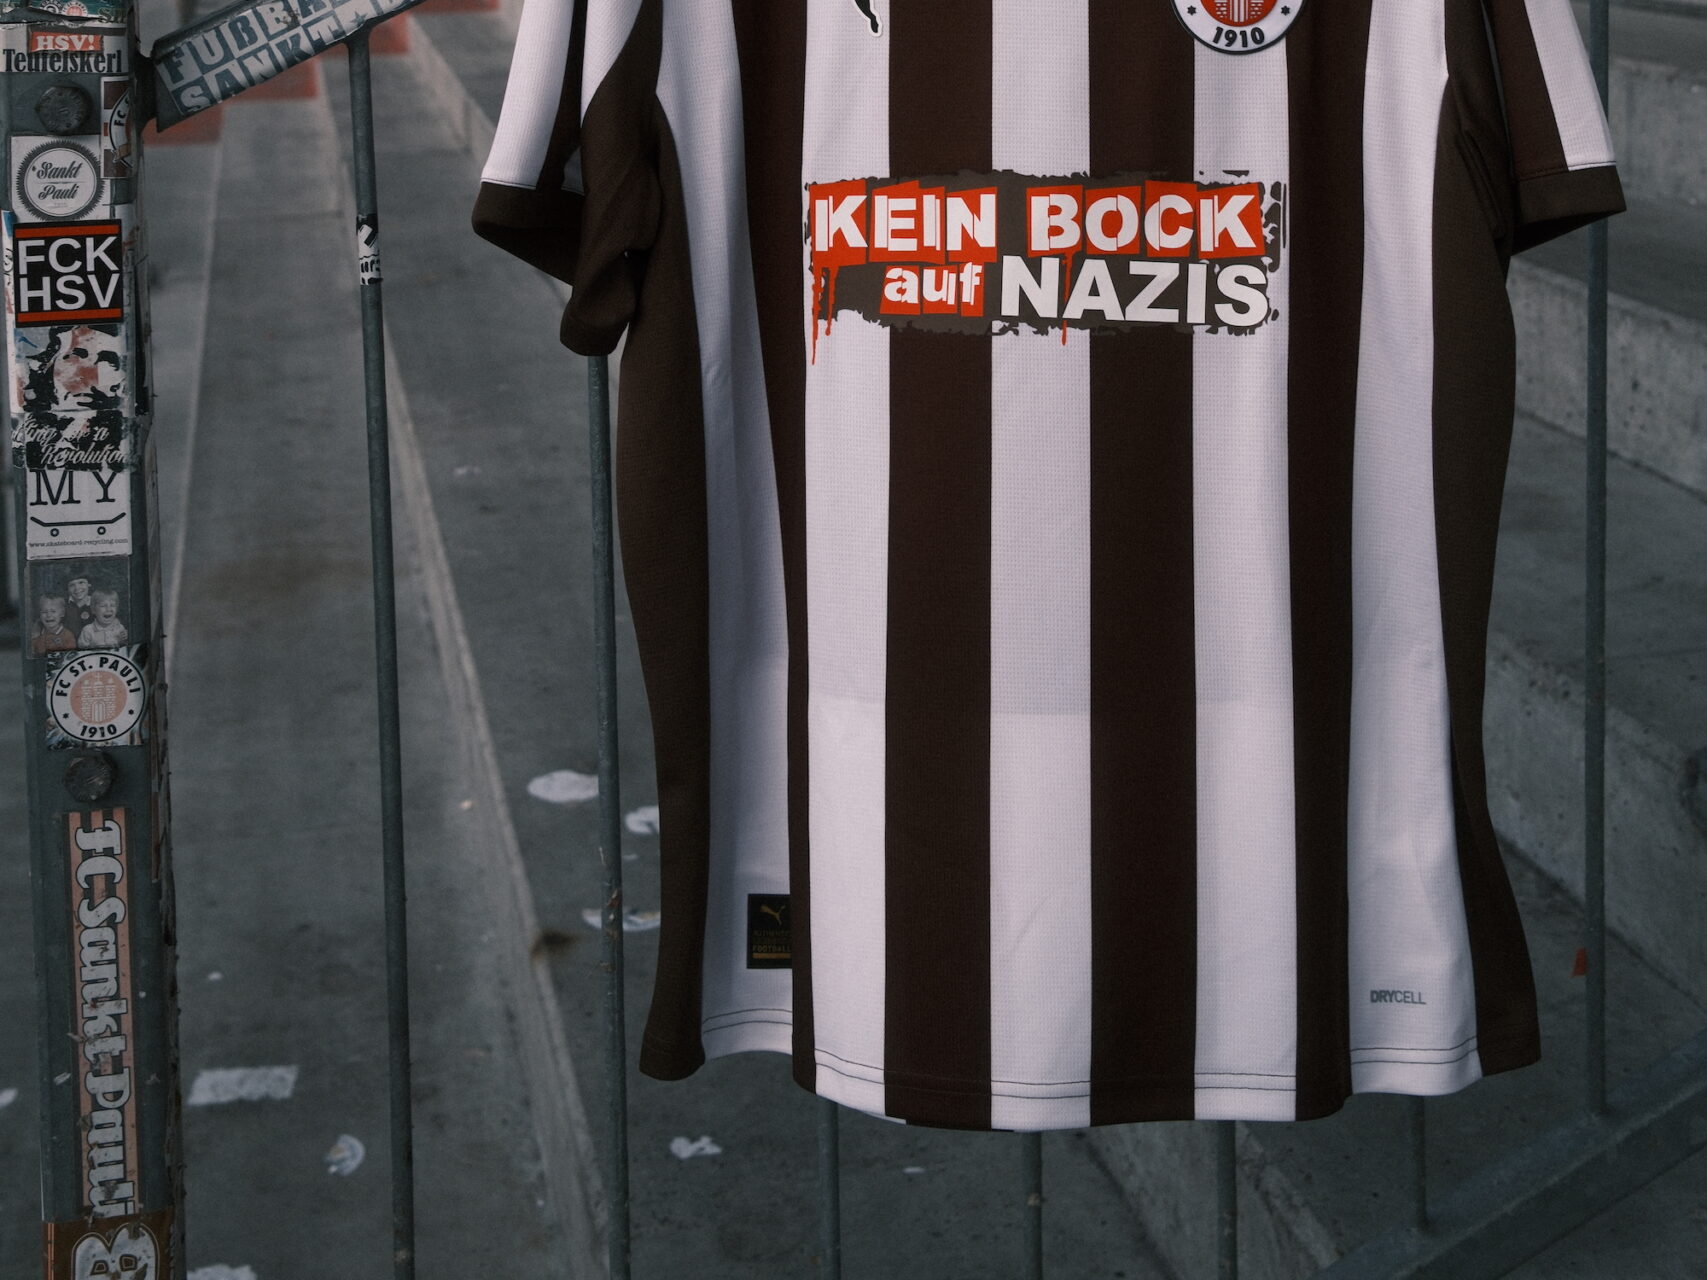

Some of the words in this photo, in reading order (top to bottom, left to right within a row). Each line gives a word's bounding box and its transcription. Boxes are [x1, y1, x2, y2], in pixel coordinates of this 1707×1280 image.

[36, 35, 95, 51] HSV!
[1212, 26, 1265, 48] 1910
[2, 49, 122, 73] Teufelskerl
[36, 160, 83, 180] Sankt
[38, 184, 80, 201] Pauli
[815, 193, 997, 252] KEIN
[1031, 193, 1257, 253] BOCK
[17, 236, 120, 275] FCK
[19, 273, 120, 313] HSV
[884, 263, 983, 307] auf
[1000, 255, 1270, 328] NAZIS
[55, 679, 69, 697] FC
[69, 656, 94, 678] ST.
[98, 656, 142, 694] PAULI
[79, 723, 118, 739] 1910
[1370, 989, 1426, 1005] DRYCELL
